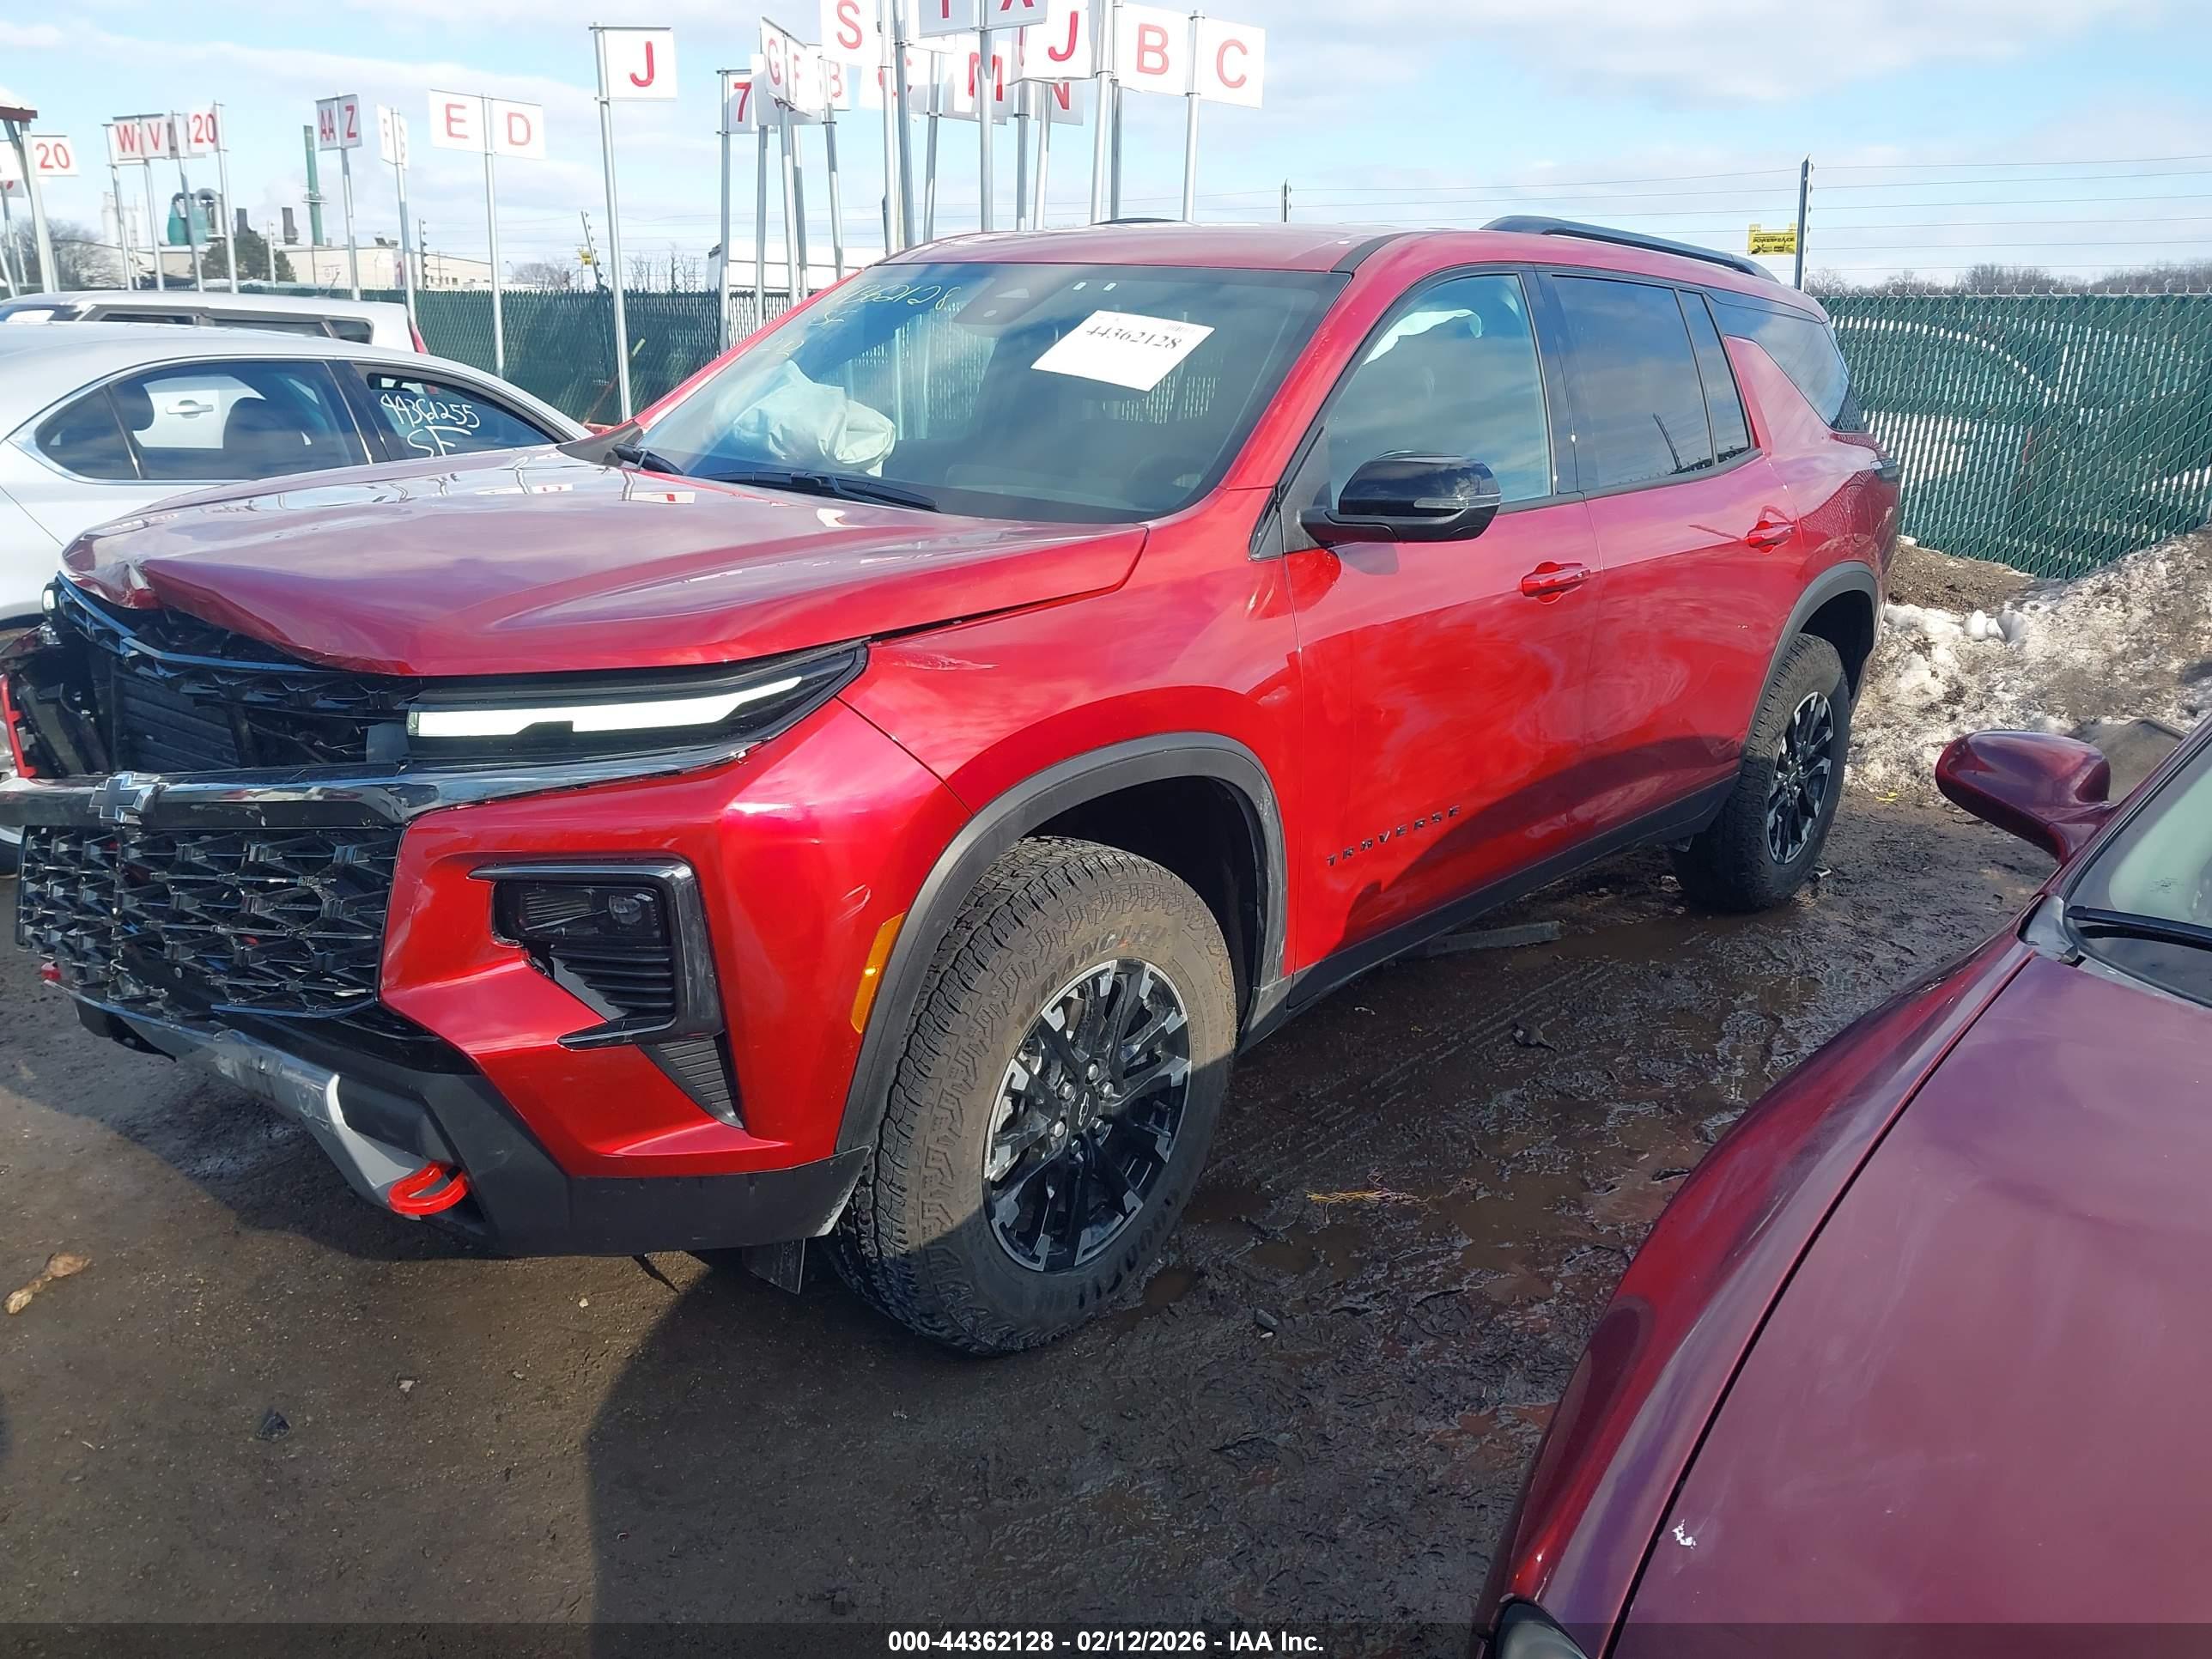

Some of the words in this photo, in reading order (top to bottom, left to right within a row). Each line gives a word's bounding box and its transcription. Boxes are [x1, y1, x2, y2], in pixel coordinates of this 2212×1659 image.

[837, 0, 862, 49] S
[1048, 10, 1079, 62] J
[629, 41, 654, 87] J
[768, 38, 781, 85] G
[1137, 22, 1170, 75] B
[1216, 39, 1248, 88] C
[734, 82, 752, 122] 7
[116, 124, 136, 153] W
[147, 123, 161, 151] V
[192, 113, 216, 144] 20
[320, 109, 337, 142] AA
[345, 105, 357, 138] Z
[445, 103, 469, 139] E
[507, 112, 531, 146] D
[35, 143, 70, 169] 20
[1086, 325, 1182, 349] 44362128
[407, 425, 471, 457] SF
[1327, 805, 1460, 866] TRAVERSE
